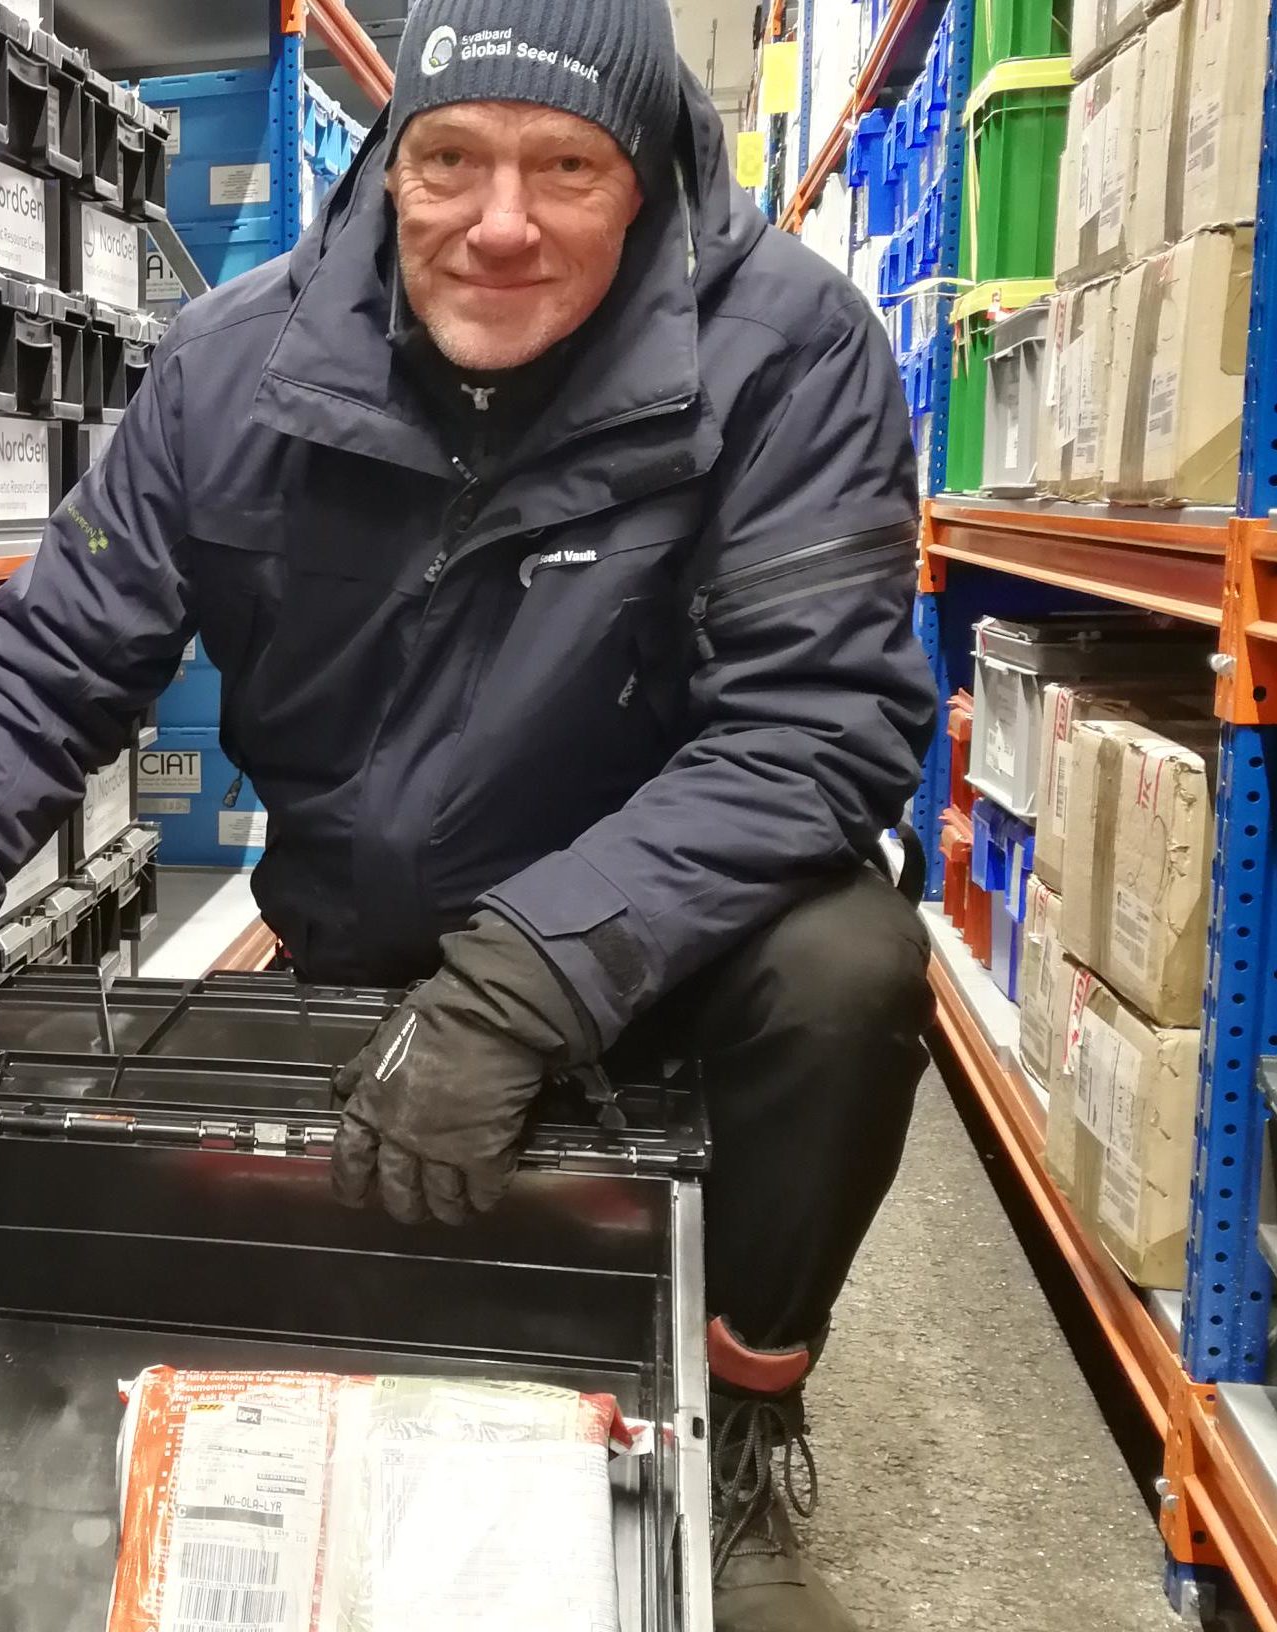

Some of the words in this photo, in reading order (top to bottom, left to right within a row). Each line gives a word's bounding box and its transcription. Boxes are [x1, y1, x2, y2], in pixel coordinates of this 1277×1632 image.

[461, 27, 512, 46] Svalbard
[461, 41, 511, 60] Global
[516, 42, 559, 64] Seed
[563, 56, 600, 84] Vault
[564, 549, 597, 561] Vault
[140, 753, 198, 775] CIAT
[223, 1495, 282, 1513] NO-OLA-LYR
